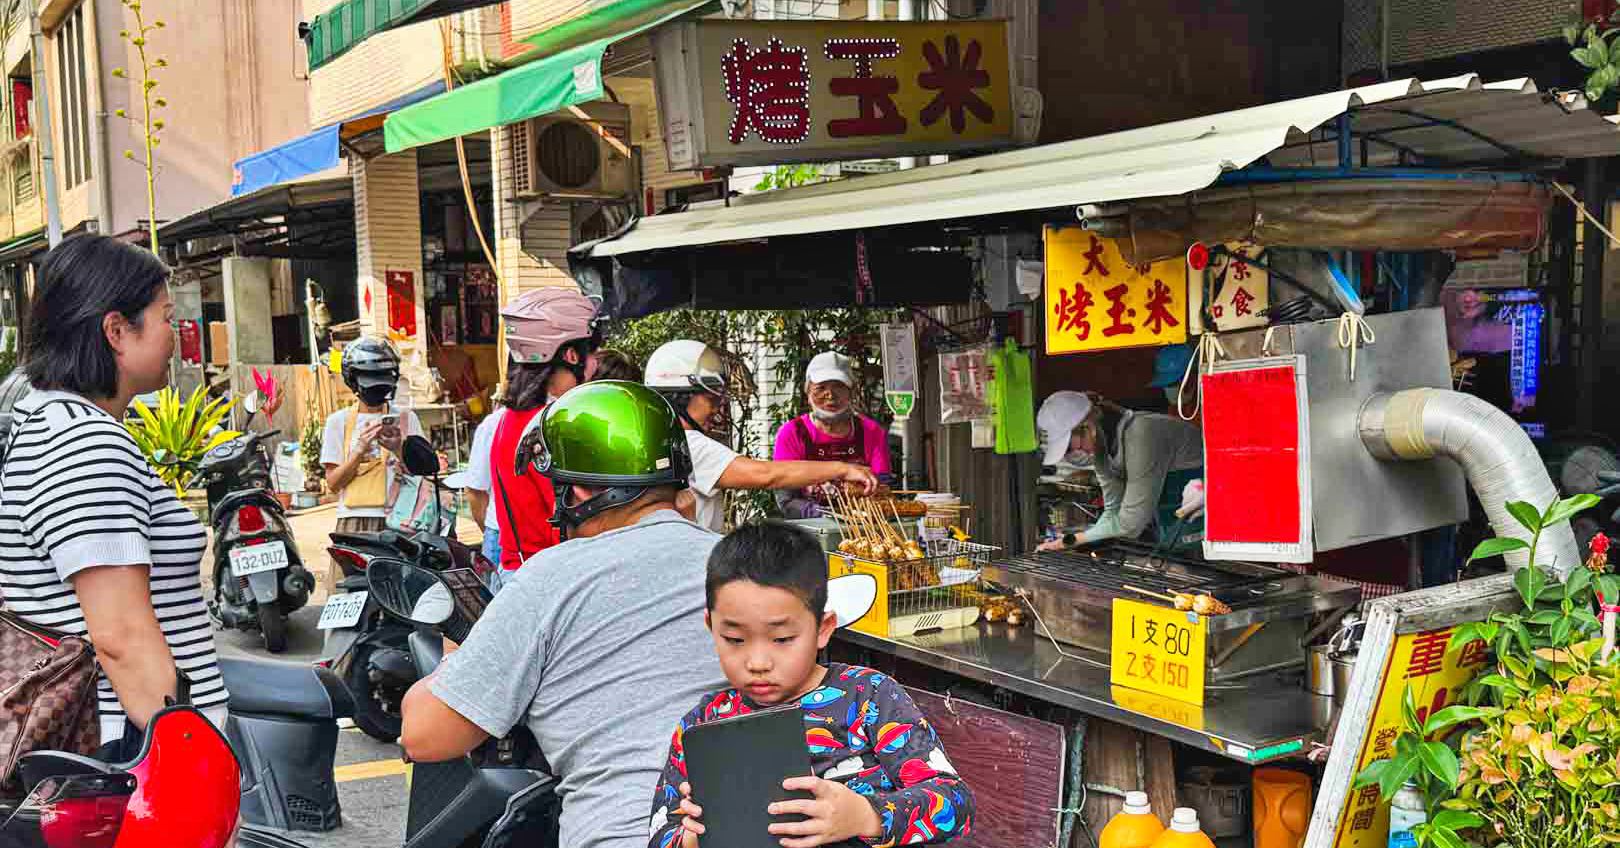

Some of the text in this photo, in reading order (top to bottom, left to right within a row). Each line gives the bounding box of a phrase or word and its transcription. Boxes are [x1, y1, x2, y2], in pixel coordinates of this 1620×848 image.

[721, 35, 994, 144] 烤玉米
[1055, 278, 1180, 342] 烤玉米
[234, 549, 285, 571] 132-DUZ
[1350, 726, 1399, 834] 營時間
